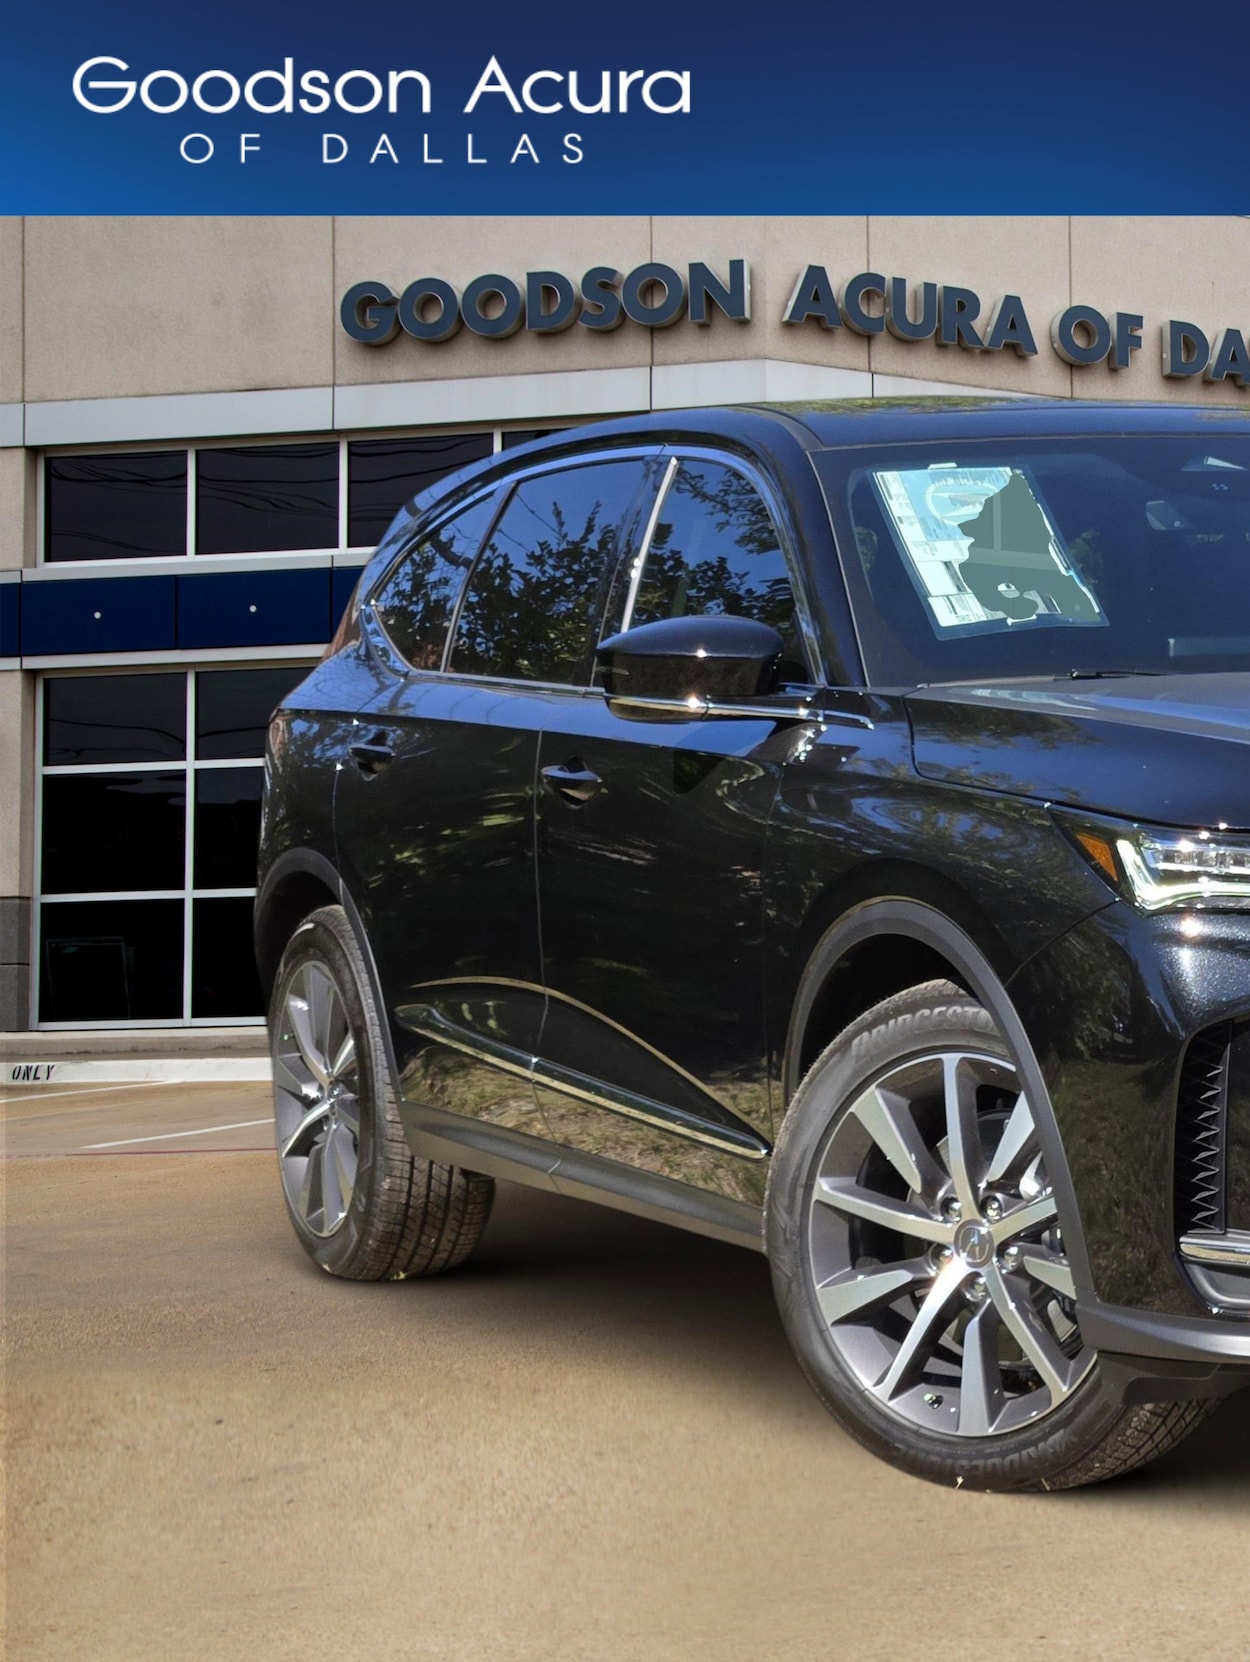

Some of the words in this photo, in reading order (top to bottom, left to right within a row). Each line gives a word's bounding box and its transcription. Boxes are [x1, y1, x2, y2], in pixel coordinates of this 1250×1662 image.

[340, 259, 751, 347] GOODSON
[782, 264, 1038, 357] ACURA
[1052, 305, 1143, 369] OF
[851, 1005, 1001, 1057] BRIDGESTO
[12, 1064, 55, 1081] ONLY
